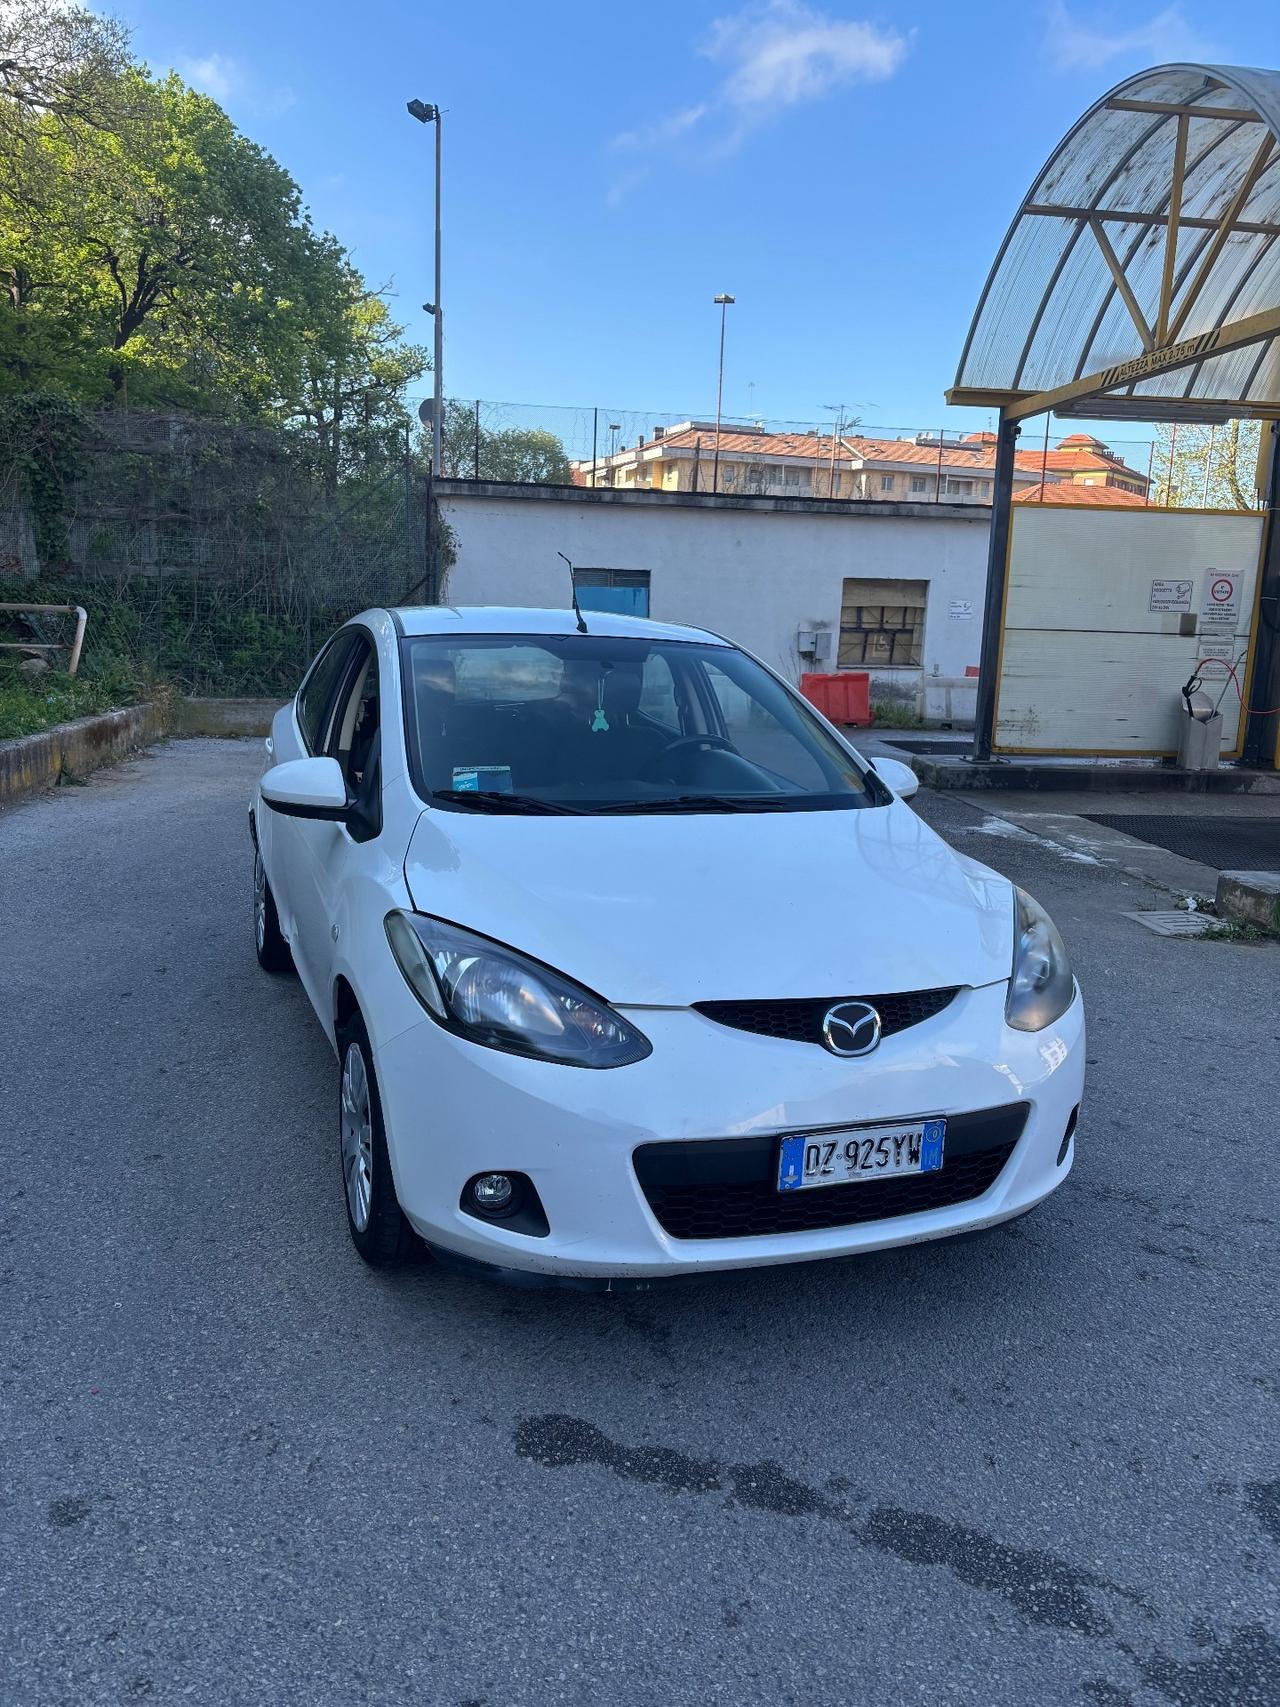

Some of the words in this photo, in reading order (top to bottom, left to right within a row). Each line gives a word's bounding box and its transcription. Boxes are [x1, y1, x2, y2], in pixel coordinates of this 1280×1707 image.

[1120, 360, 1149, 376] ALTEZZA
[1151, 352, 1168, 366] MAX
[1169, 345, 1185, 360] 2.75
[1187, 344, 1195, 353] m
[805, 1140, 838, 1177] DZ
[845, 1133, 922, 1170] 925YW
